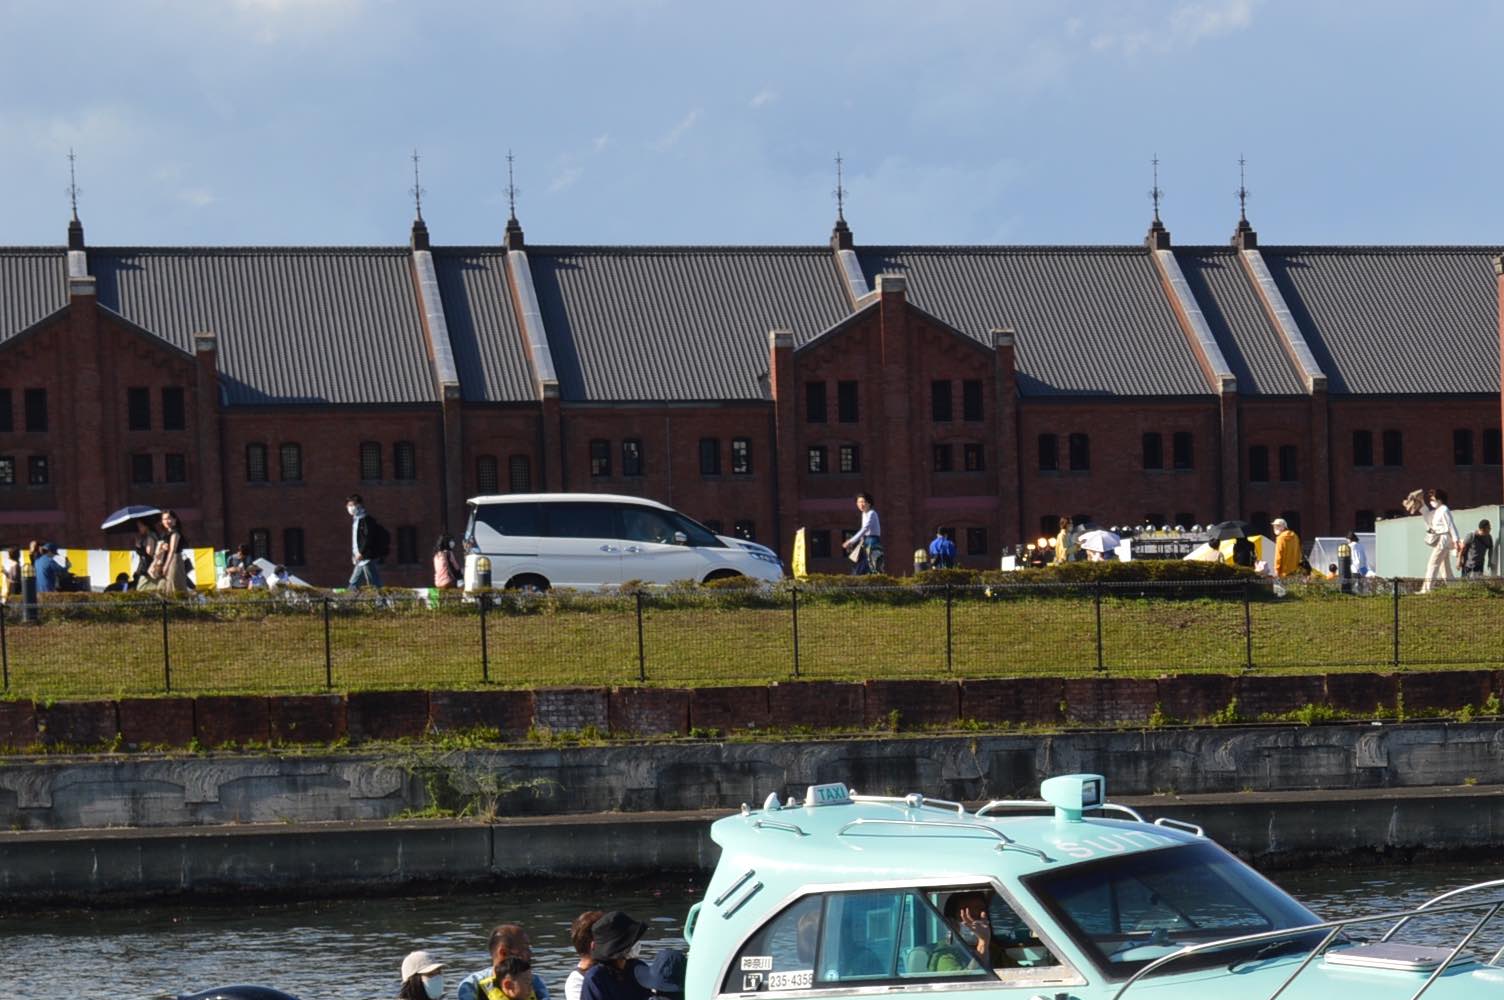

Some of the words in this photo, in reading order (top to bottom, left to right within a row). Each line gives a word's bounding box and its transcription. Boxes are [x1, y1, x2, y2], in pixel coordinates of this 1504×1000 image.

[818, 786, 846, 801] TAXI
[1055, 831, 1172, 858] SUIT
[743, 958, 771, 969] 神奈川
